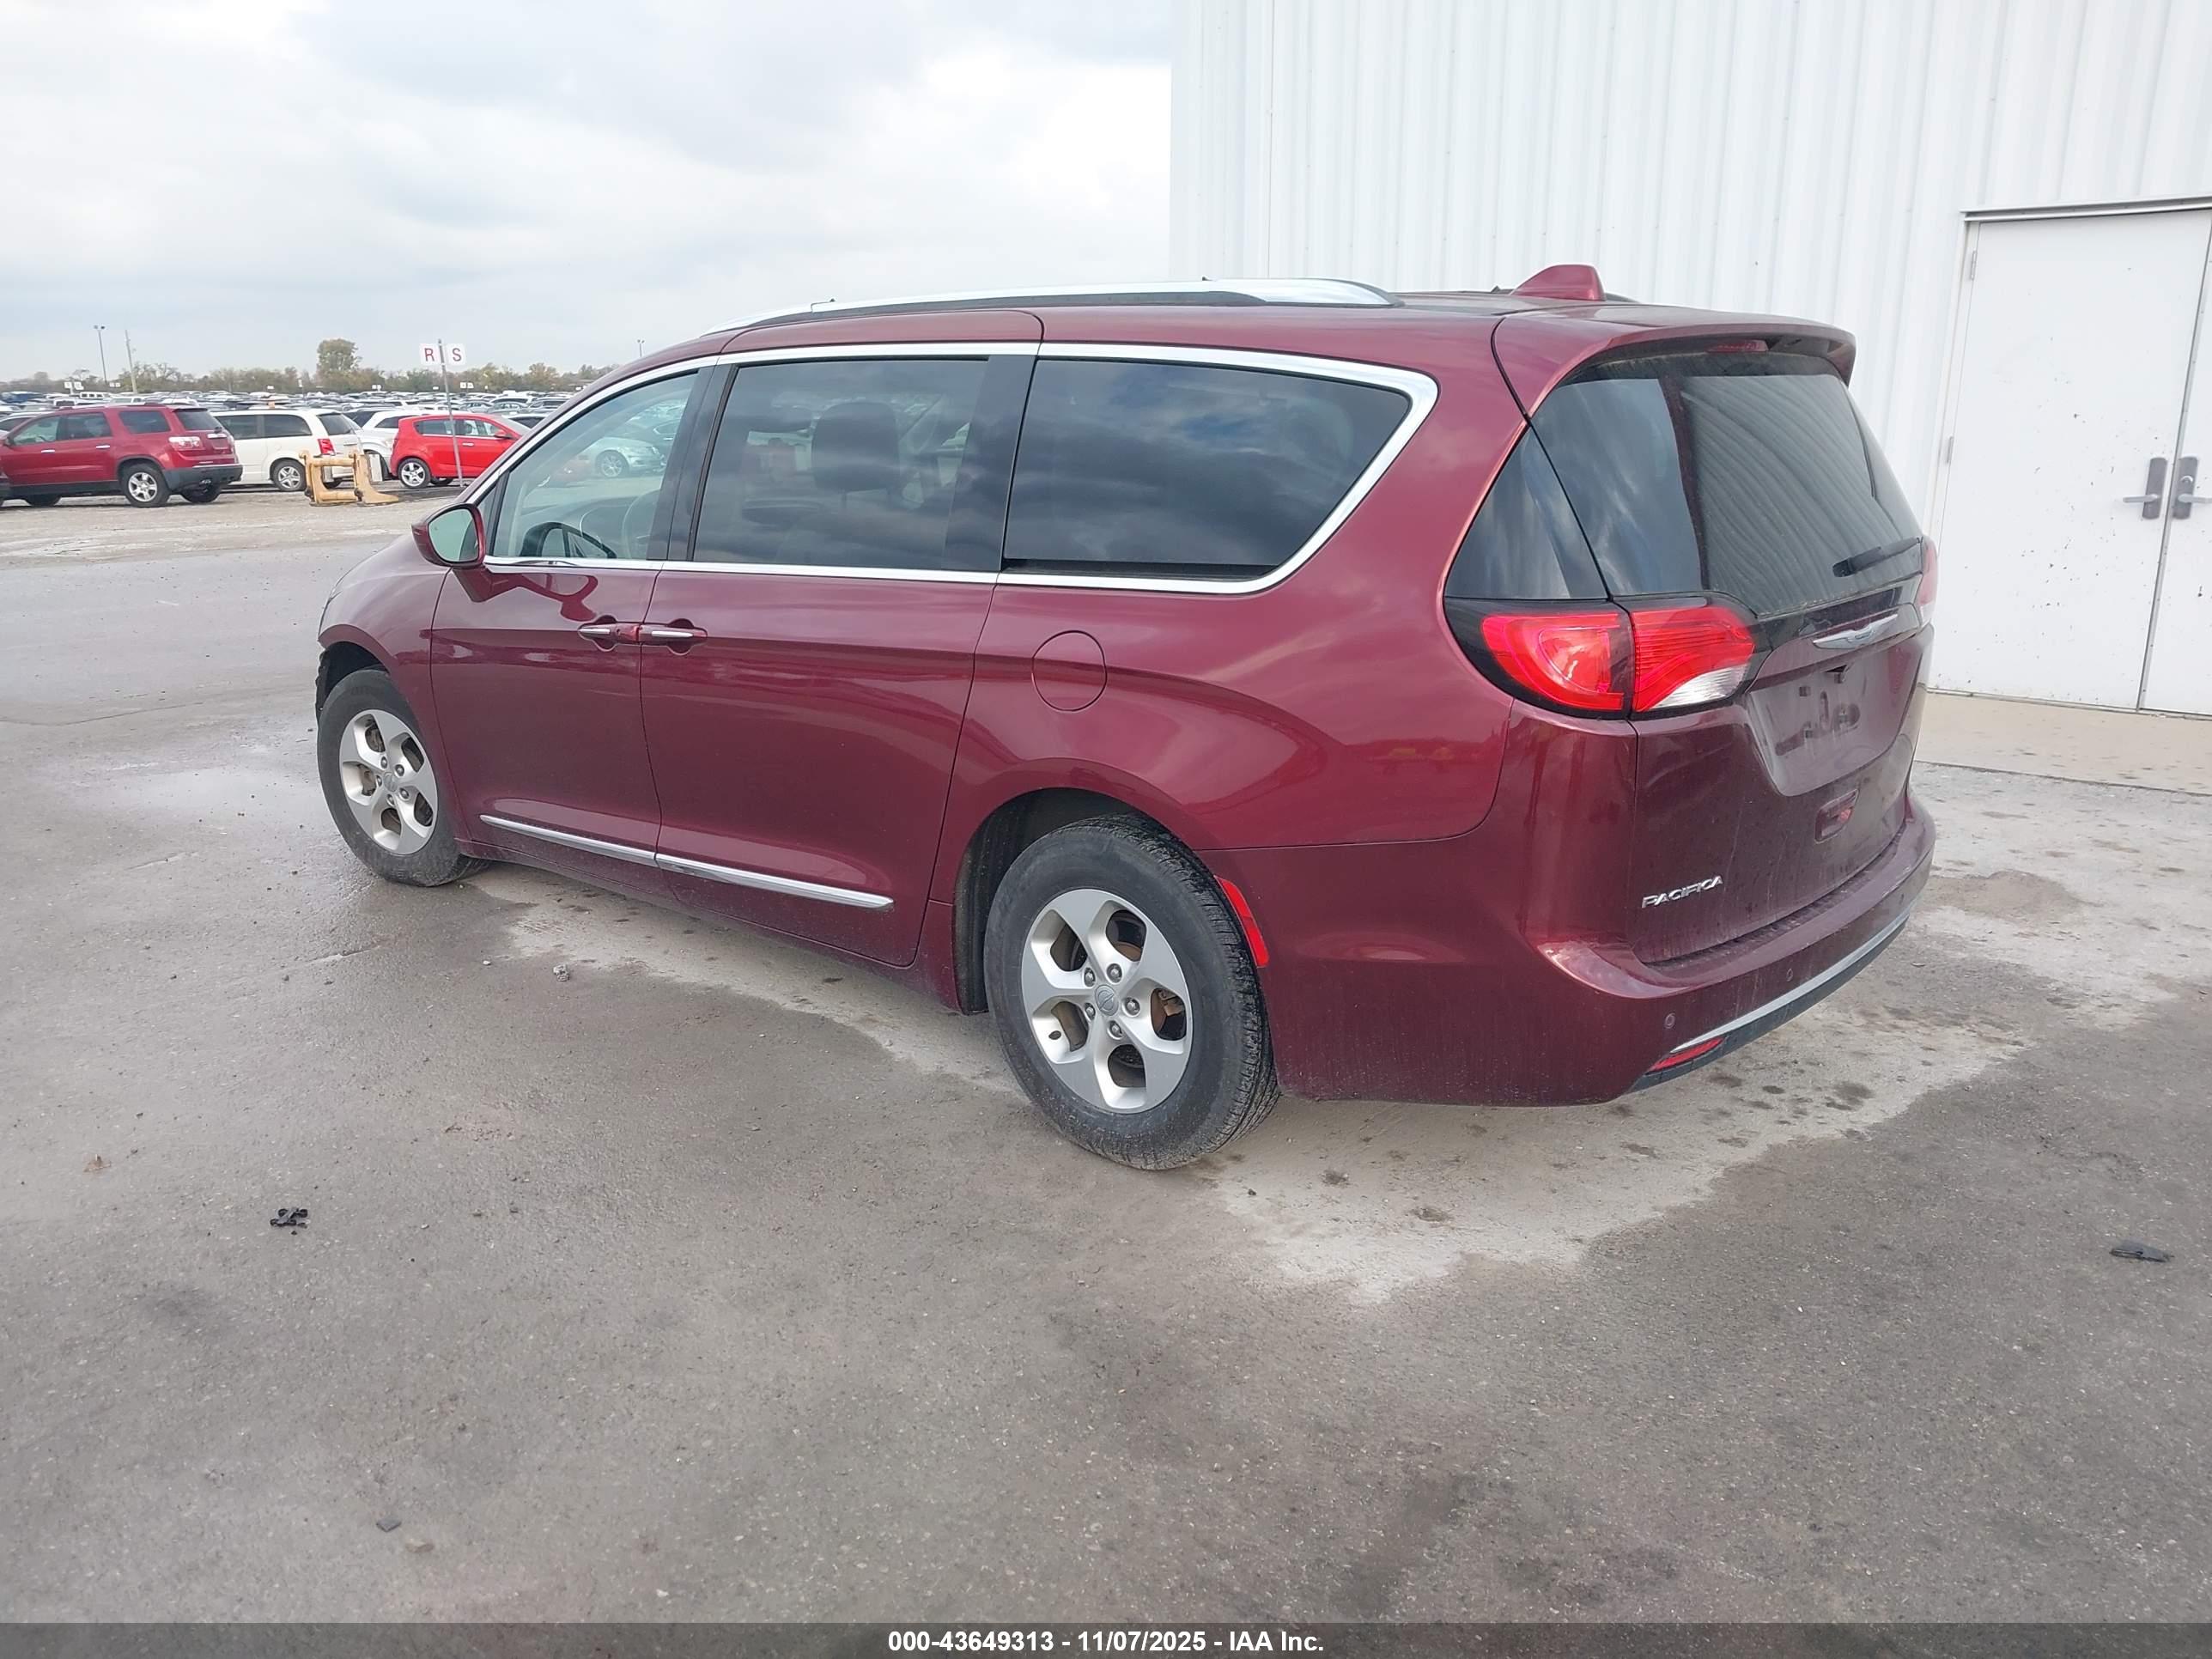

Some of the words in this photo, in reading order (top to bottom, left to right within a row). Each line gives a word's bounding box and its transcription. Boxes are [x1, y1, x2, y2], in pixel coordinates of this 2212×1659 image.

[424, 347, 435, 362] R
[452, 347, 462, 362] S
[1641, 875, 1723, 908] PACIFICA
